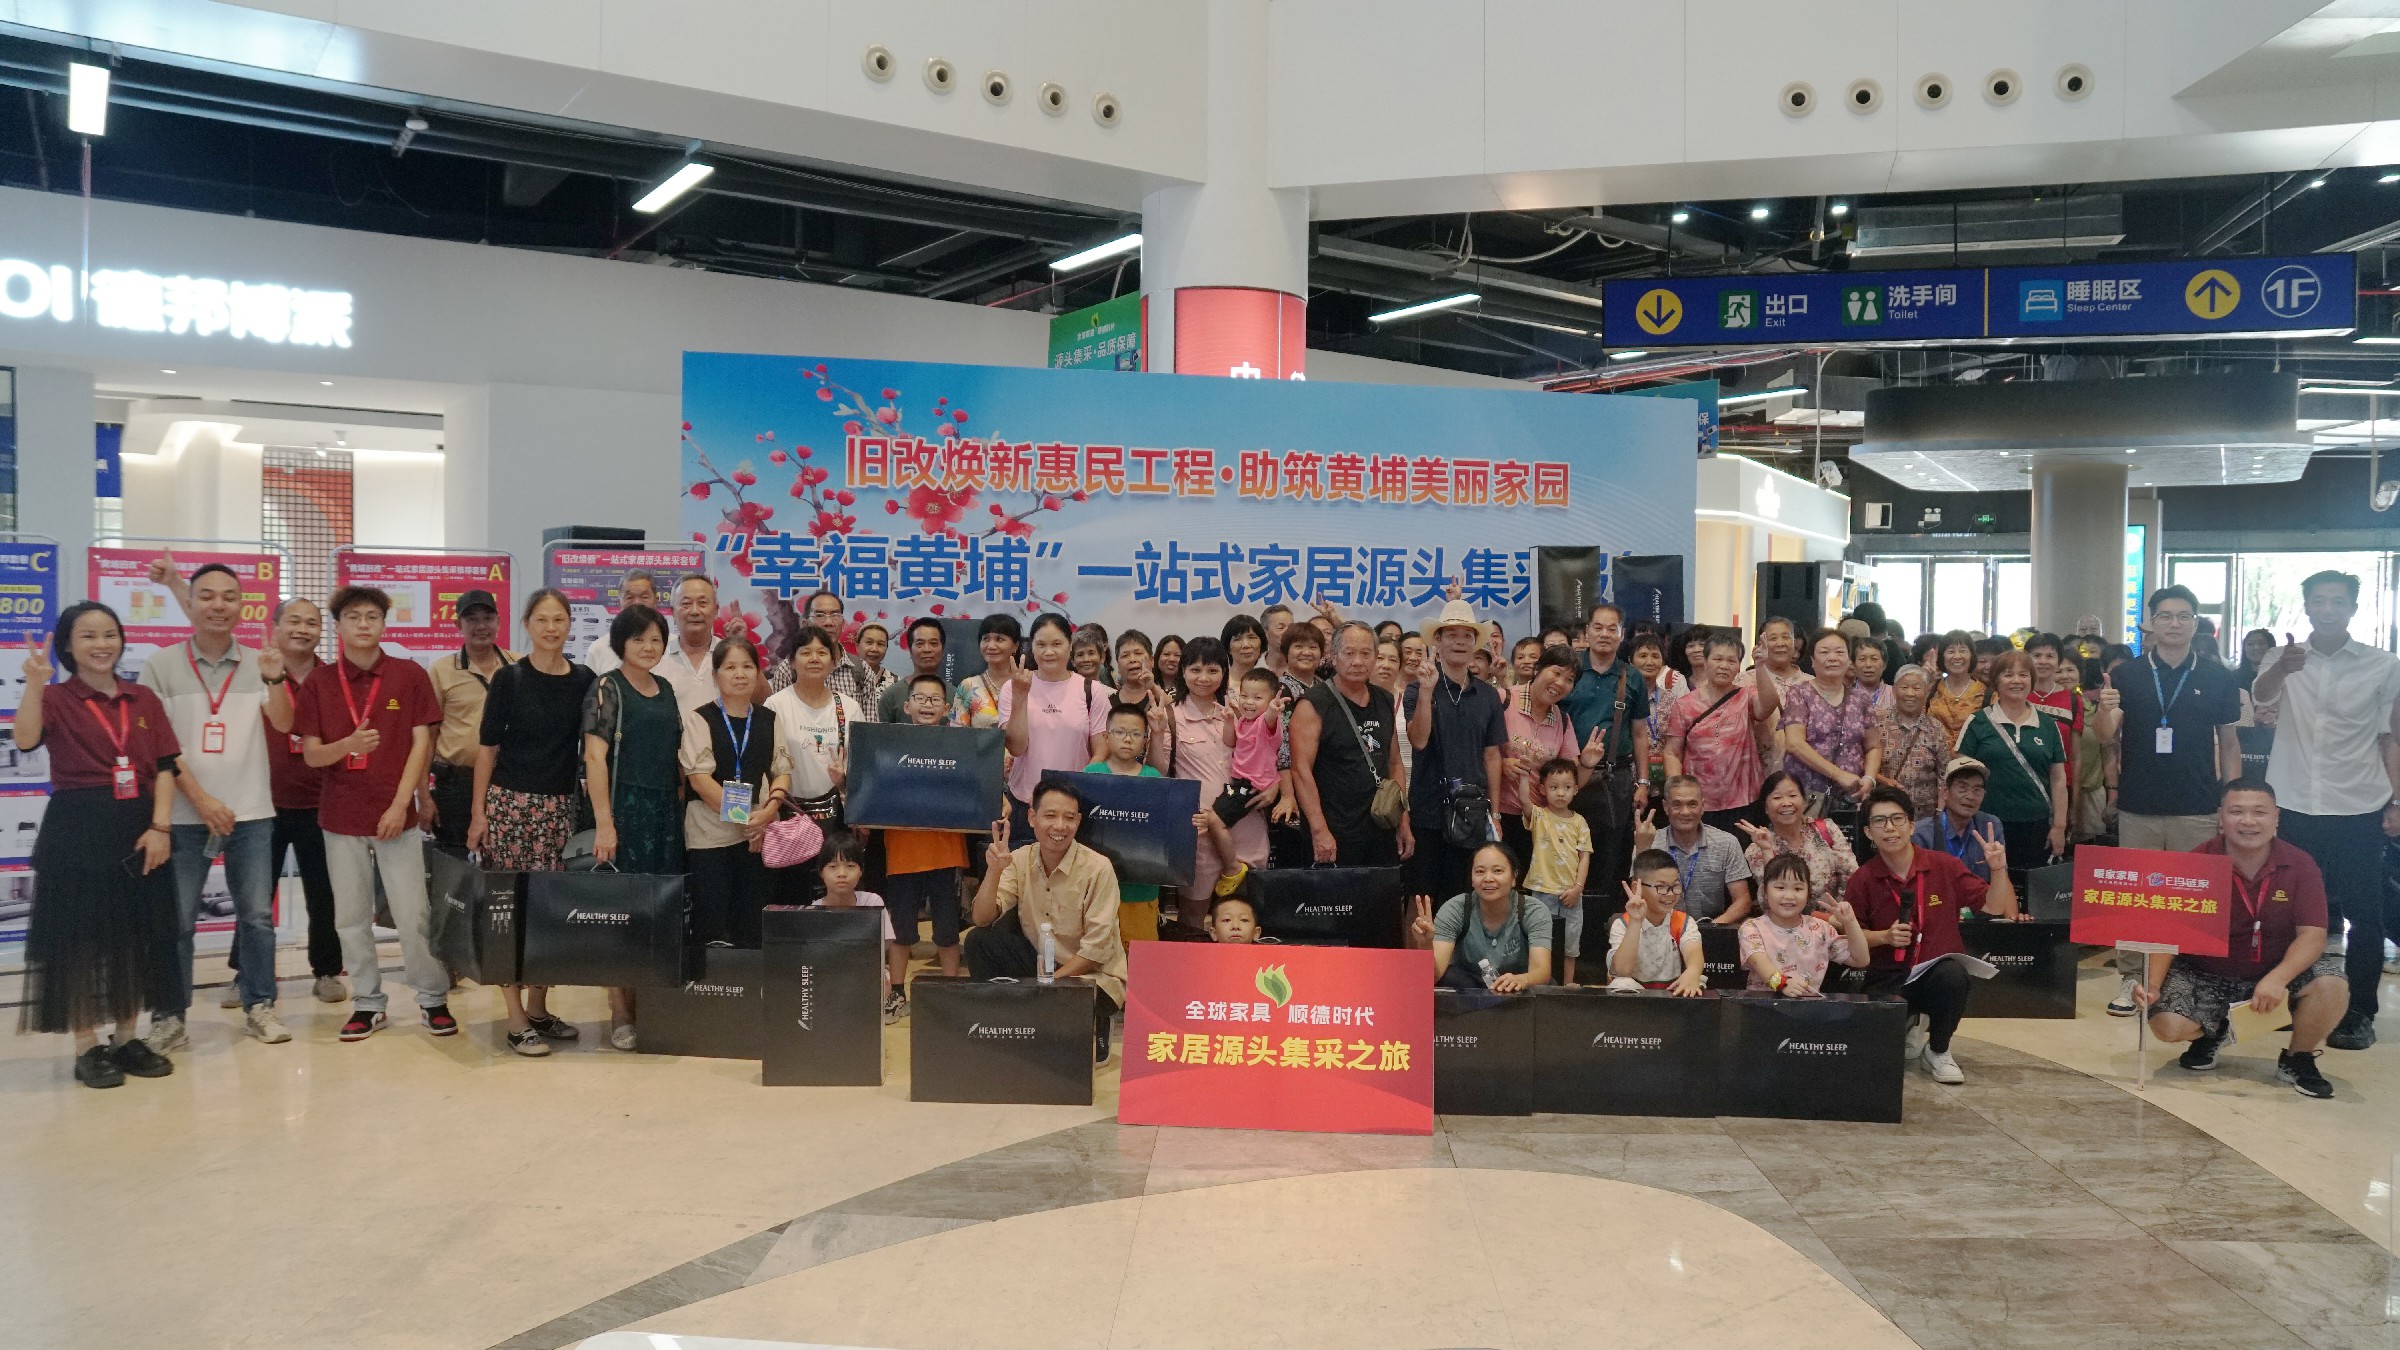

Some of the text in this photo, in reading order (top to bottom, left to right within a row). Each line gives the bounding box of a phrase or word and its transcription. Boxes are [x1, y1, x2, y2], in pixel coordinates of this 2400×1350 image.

[2066, 278, 2142, 301] 睡眠区
[2266, 277, 2316, 309] 1F
[1888, 284, 1957, 307] 洗手间
[1765, 293, 1808, 316] 出口
[2067, 301, 2132, 312] Sleep Center
[1888, 309, 1918, 320] Toilet
[1765, 317, 1786, 327] Exit
[844, 434, 1570, 508] 旧改焕新惠民工程·助筑黄埔美丽家园
[30, 552, 50, 572] C
[257, 562, 274, 581] B
[487, 563, 504, 581] A
[907, 756, 957, 767] HEALTHY SLEEP
[1099, 808, 1150, 819] HEALTHY SLEEP
[2083, 888, 2218, 914] 家居源头集采之旅
[1304, 904, 1353, 913] HEALTHY SLEEP
[576, 912, 630, 921] HEALTHY SLEEP
[1717, 962, 1735, 970] SLEEP
[694, 984, 744, 994] HEALTHY SLEEP
[801, 965, 809, 1020] HEALTHY SLEEP
[1185, 999, 1375, 1027] 全球家具 顺德时代
[978, 1026, 1036, 1035] HEALTHY SLEEP
[1456, 1036, 1478, 1044] SLEEP
[1603, 1035, 1662, 1046] HEALTHY SLEEP
[1146, 1031, 1411, 1073] 家居源头集采之旅
[1789, 1042, 1848, 1052] HEALTHY SLEEP
